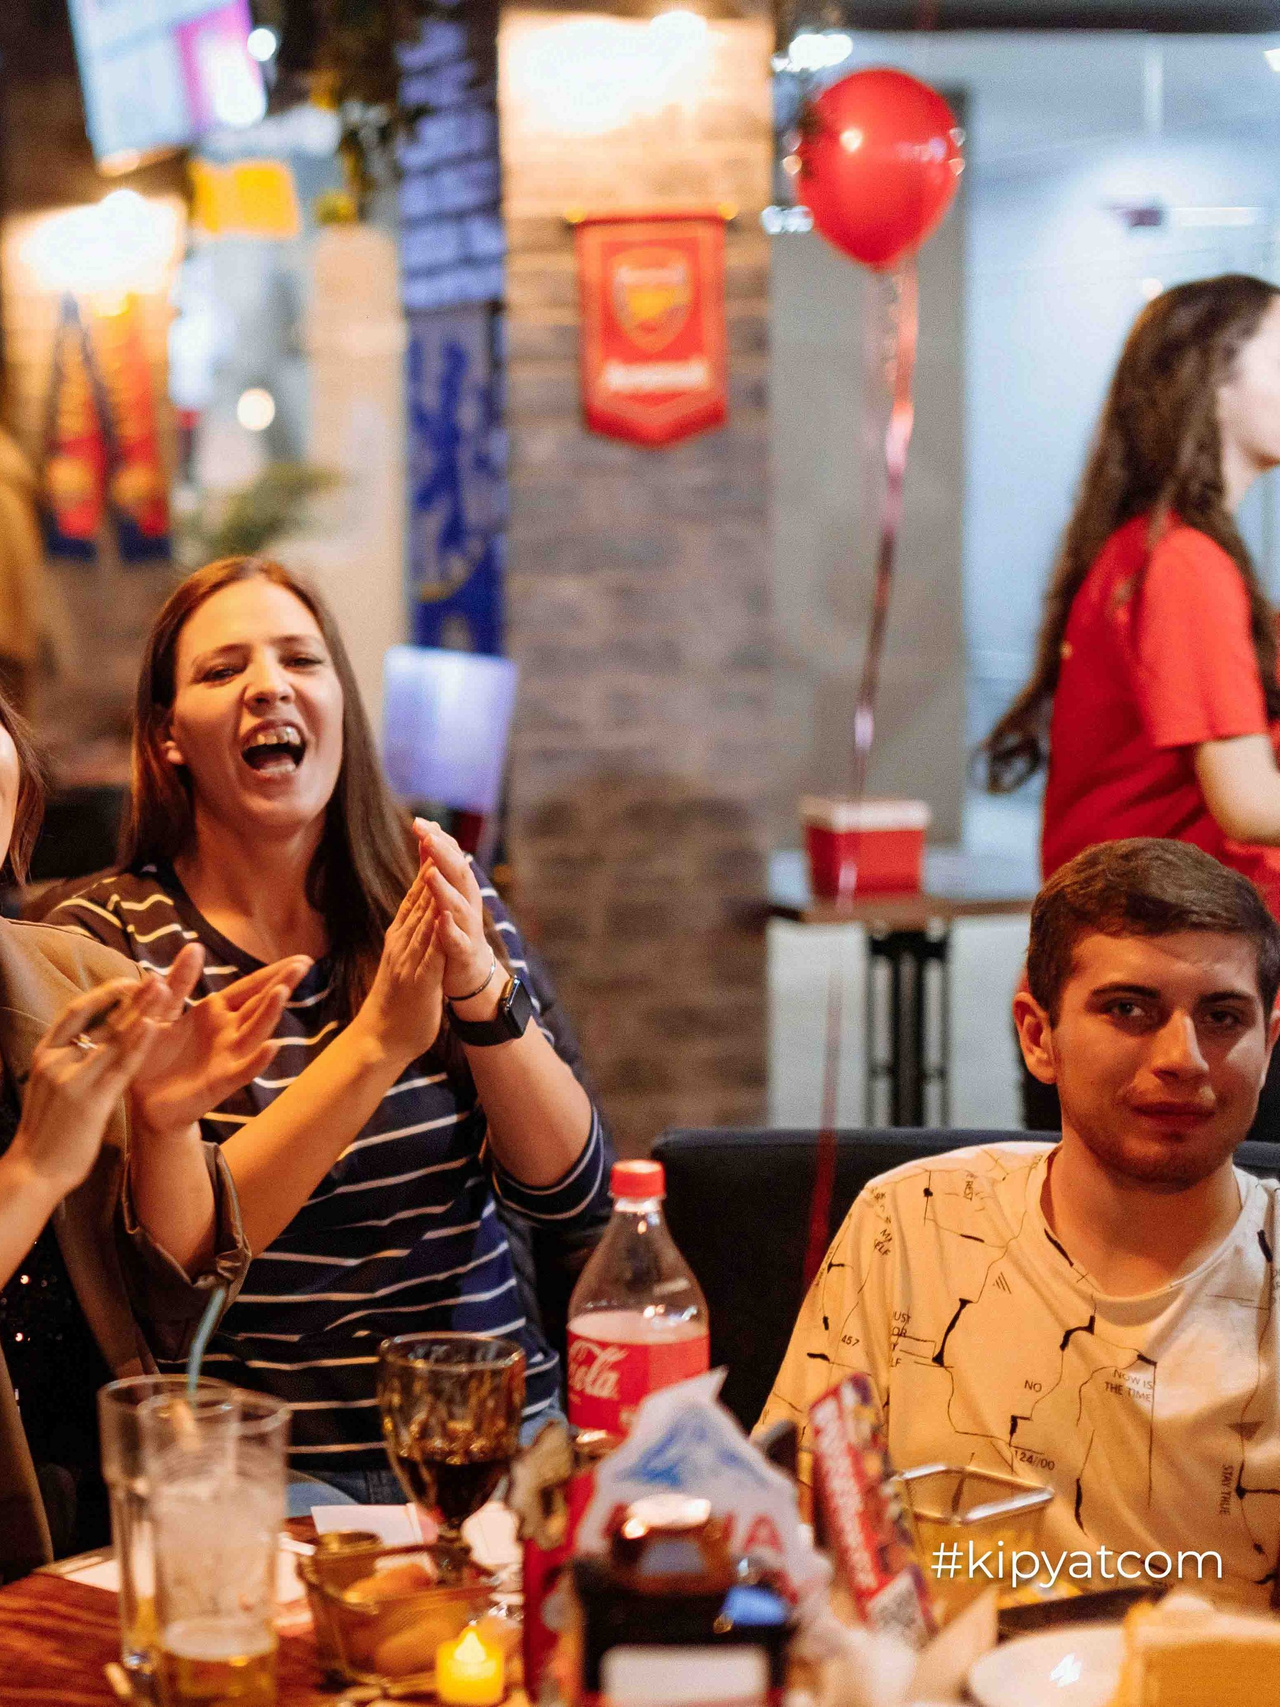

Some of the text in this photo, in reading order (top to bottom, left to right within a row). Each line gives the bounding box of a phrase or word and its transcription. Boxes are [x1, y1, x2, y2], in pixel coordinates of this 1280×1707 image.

[893, 1310, 911, 1324] UST
[892, 1326, 907, 1338] OR
[841, 1334, 860, 1347] 457
[1024, 1379, 1042, 1393] NO
[1113, 1369, 1153, 1390] NOW IS
[1105, 1381, 1151, 1400] THE TIME
